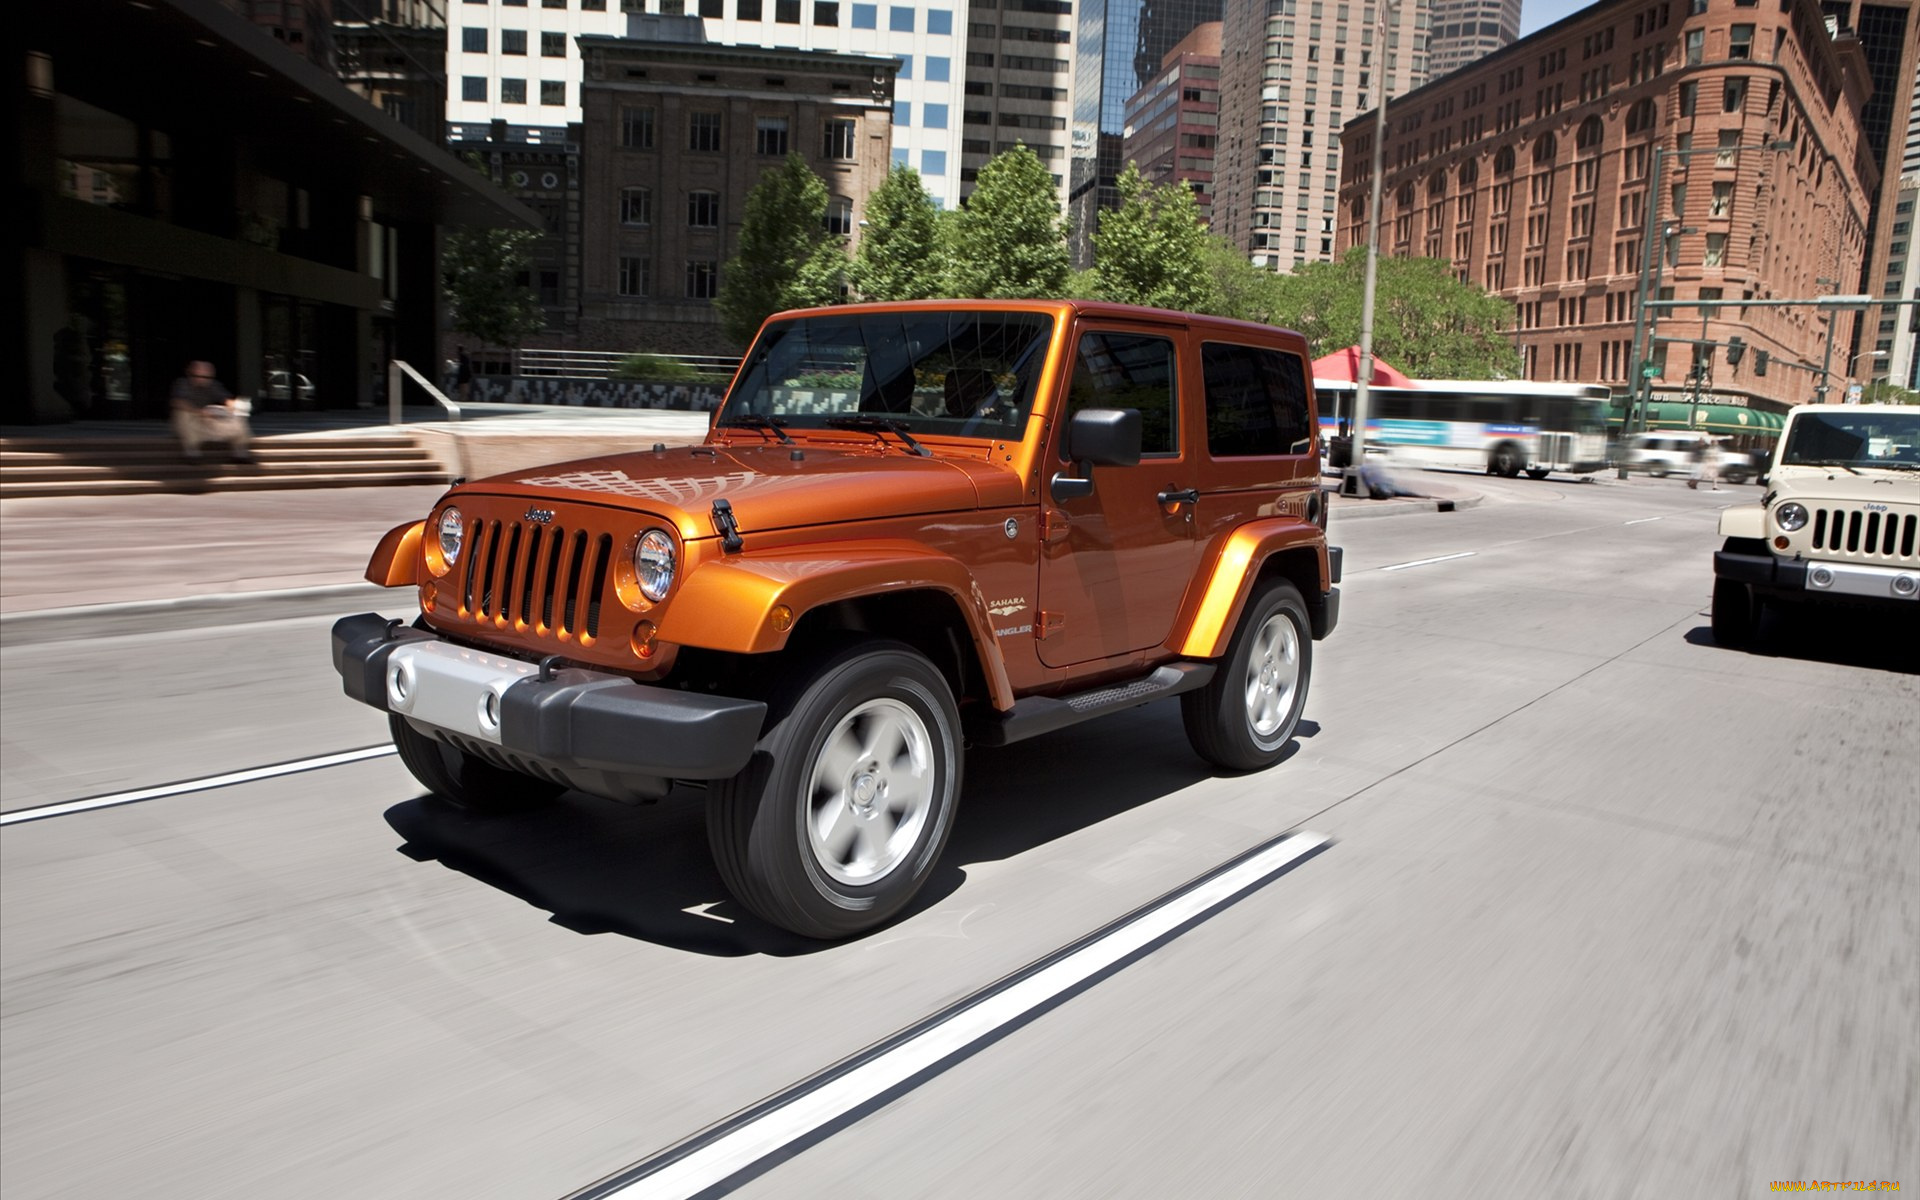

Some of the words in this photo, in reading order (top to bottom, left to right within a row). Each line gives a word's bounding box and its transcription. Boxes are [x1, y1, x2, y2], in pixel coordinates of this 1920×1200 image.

[1863, 503, 1888, 512] Jeep
[524, 504, 555, 525] Jeep
[990, 597, 1025, 607] SAHARA
[995, 625, 1033, 637] ANGLER
